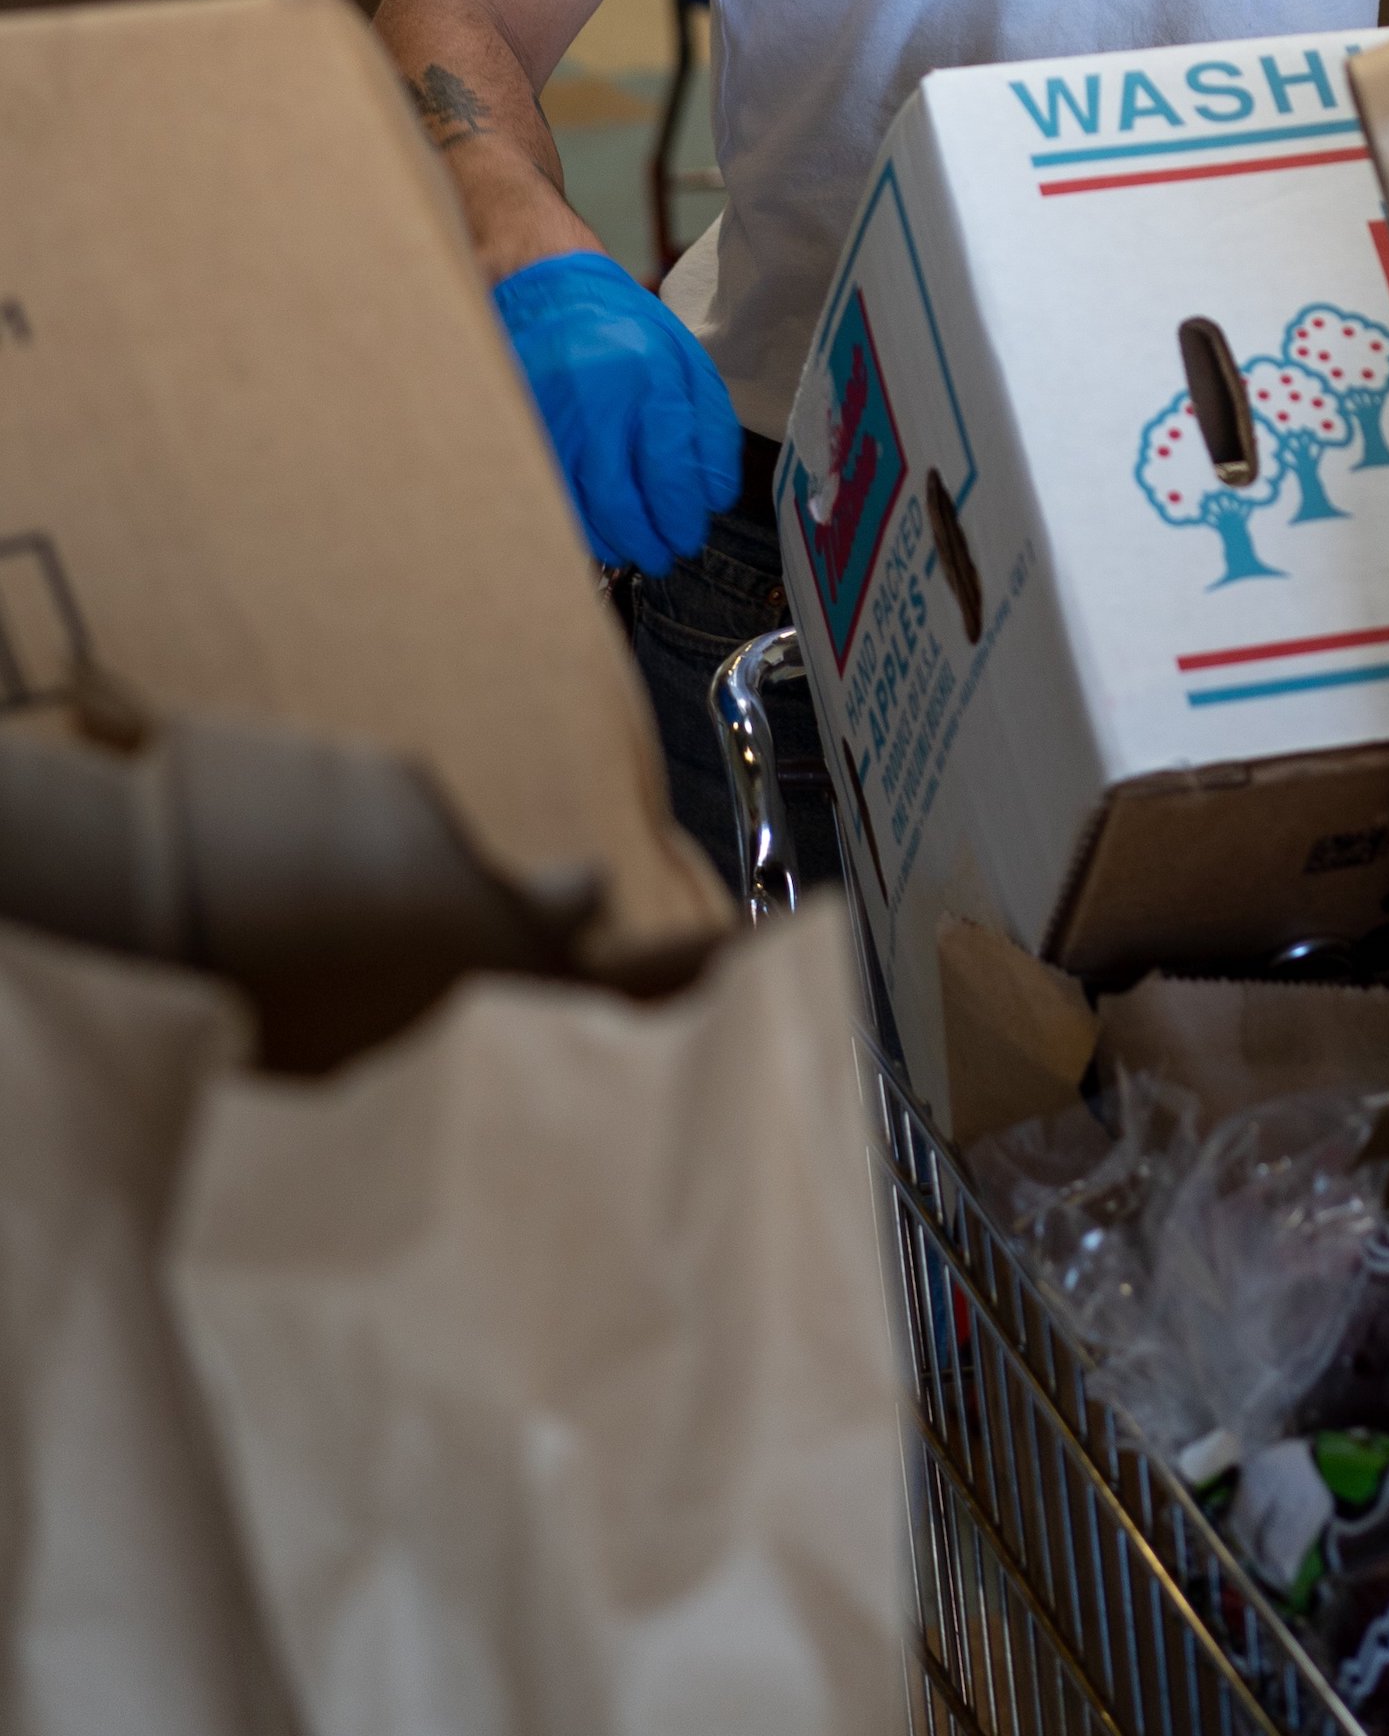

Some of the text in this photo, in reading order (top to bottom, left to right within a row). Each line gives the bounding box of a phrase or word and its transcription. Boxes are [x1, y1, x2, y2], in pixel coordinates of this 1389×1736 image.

[1008, 44, 1361, 139] WASH
[844, 631, 877, 736] HAND
[872, 494, 923, 643] PACKED
[868, 574, 927, 762] APPLES
